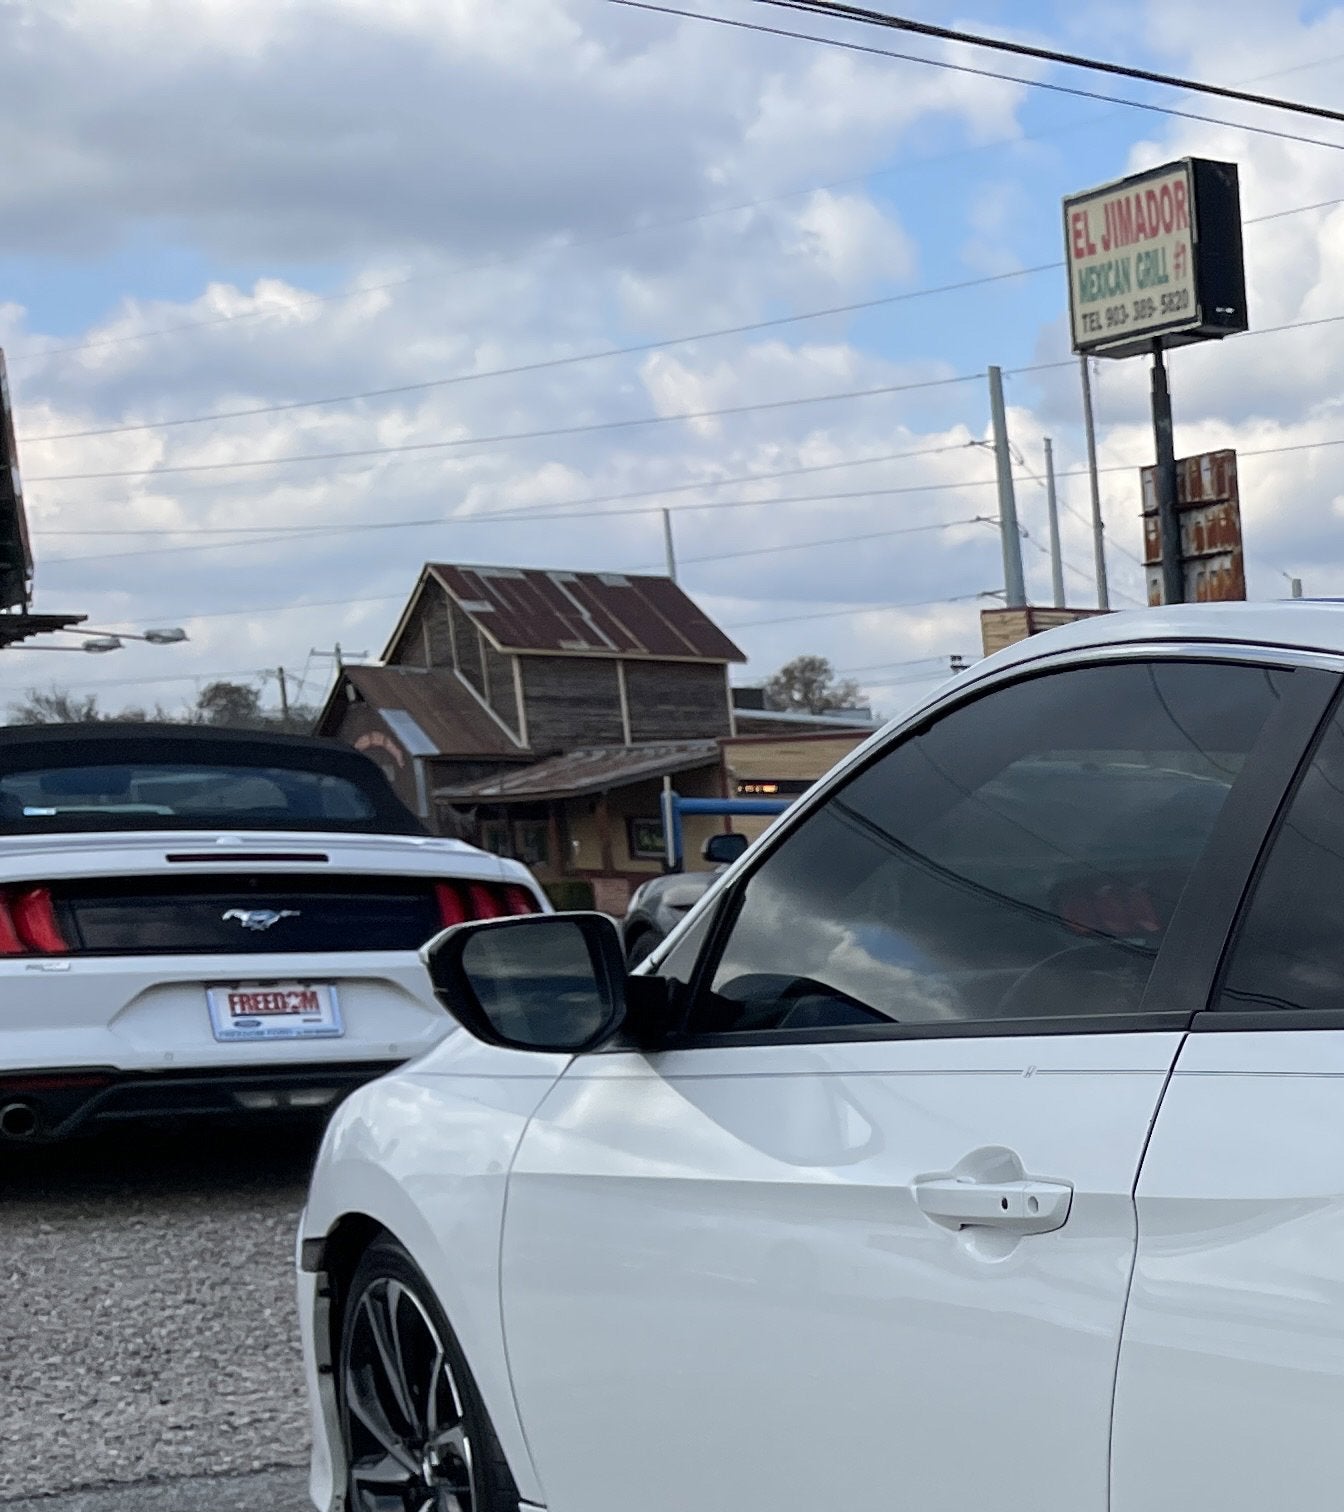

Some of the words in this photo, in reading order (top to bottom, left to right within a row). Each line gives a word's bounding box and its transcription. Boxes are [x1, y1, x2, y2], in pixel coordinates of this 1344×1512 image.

[1072, 210, 1097, 259] EL
[1101, 180, 1189, 251] JIMADOR
[1078, 256, 1132, 304] MEXICAN
[1135, 246, 1169, 289] GRILL
[1081, 311, 1103, 334] TEL
[228, 991, 320, 1014] FREEDOM
